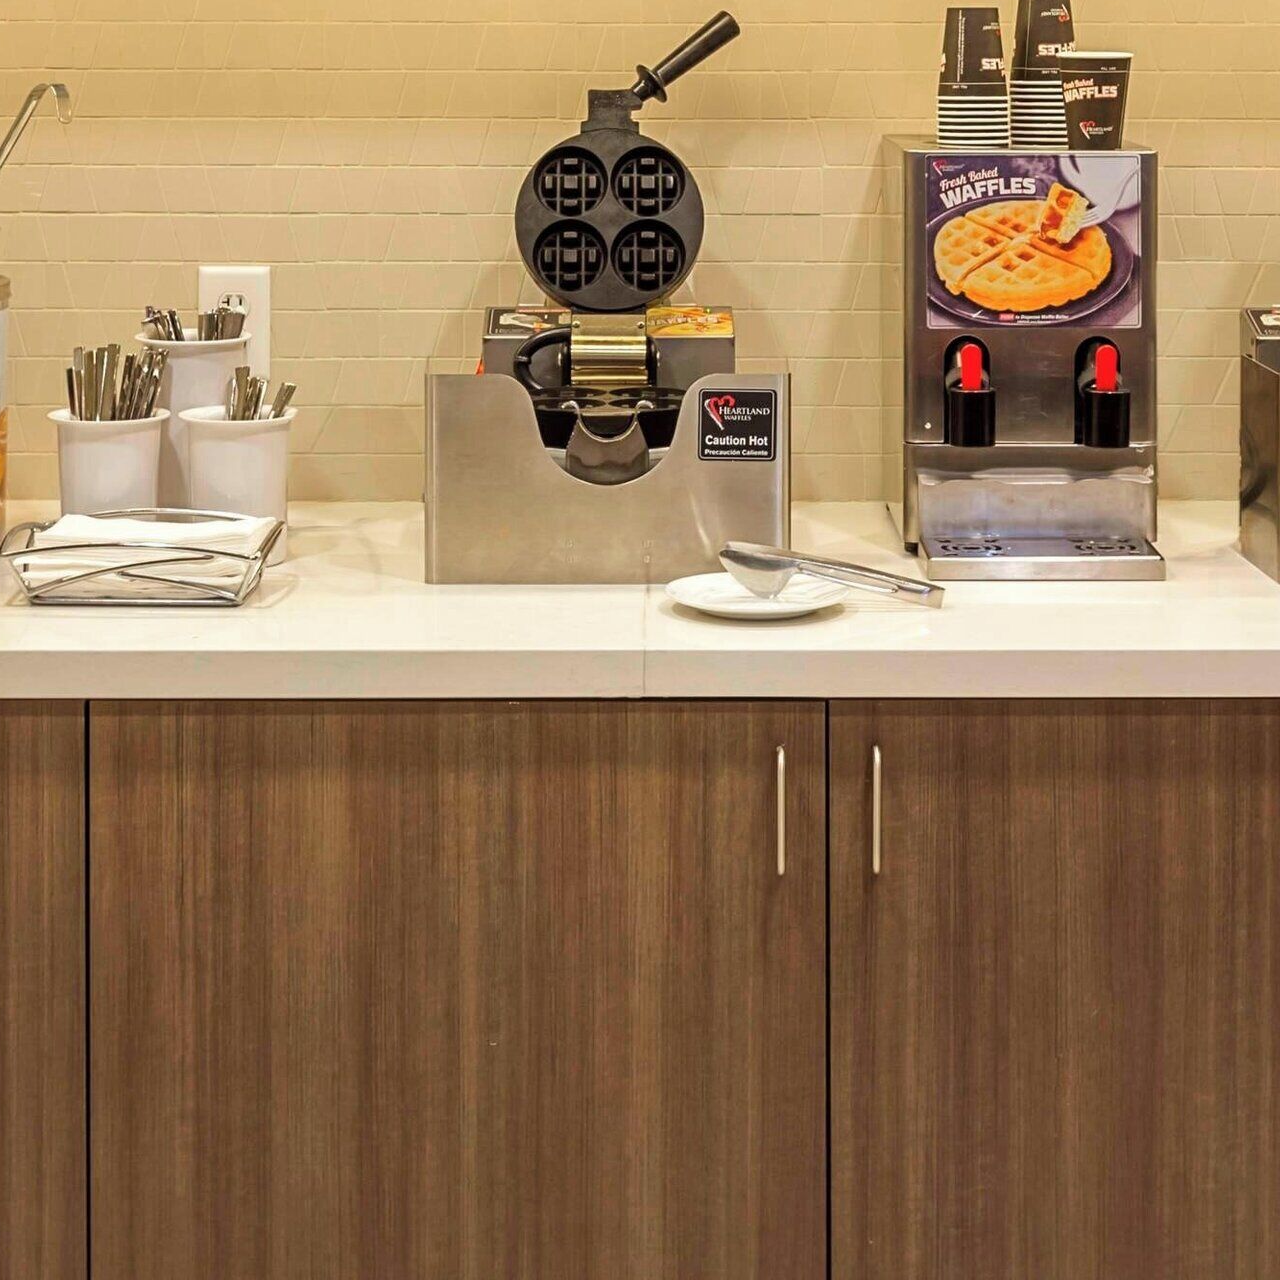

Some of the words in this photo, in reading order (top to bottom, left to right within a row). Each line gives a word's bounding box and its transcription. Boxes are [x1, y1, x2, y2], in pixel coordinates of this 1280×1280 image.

[1063, 85, 1118, 103] WAFFLES
[939, 172, 967, 191] Fresh
[968, 166, 999, 183] Baked
[939, 177, 1036, 209] WAFFLES
[719, 406, 771, 416] HEARTLAND
[705, 434, 746, 445] Caution
[749, 435, 768, 446] Hot
[704, 448, 740, 456] Precaución
[742, 448, 769, 456] Caliente
